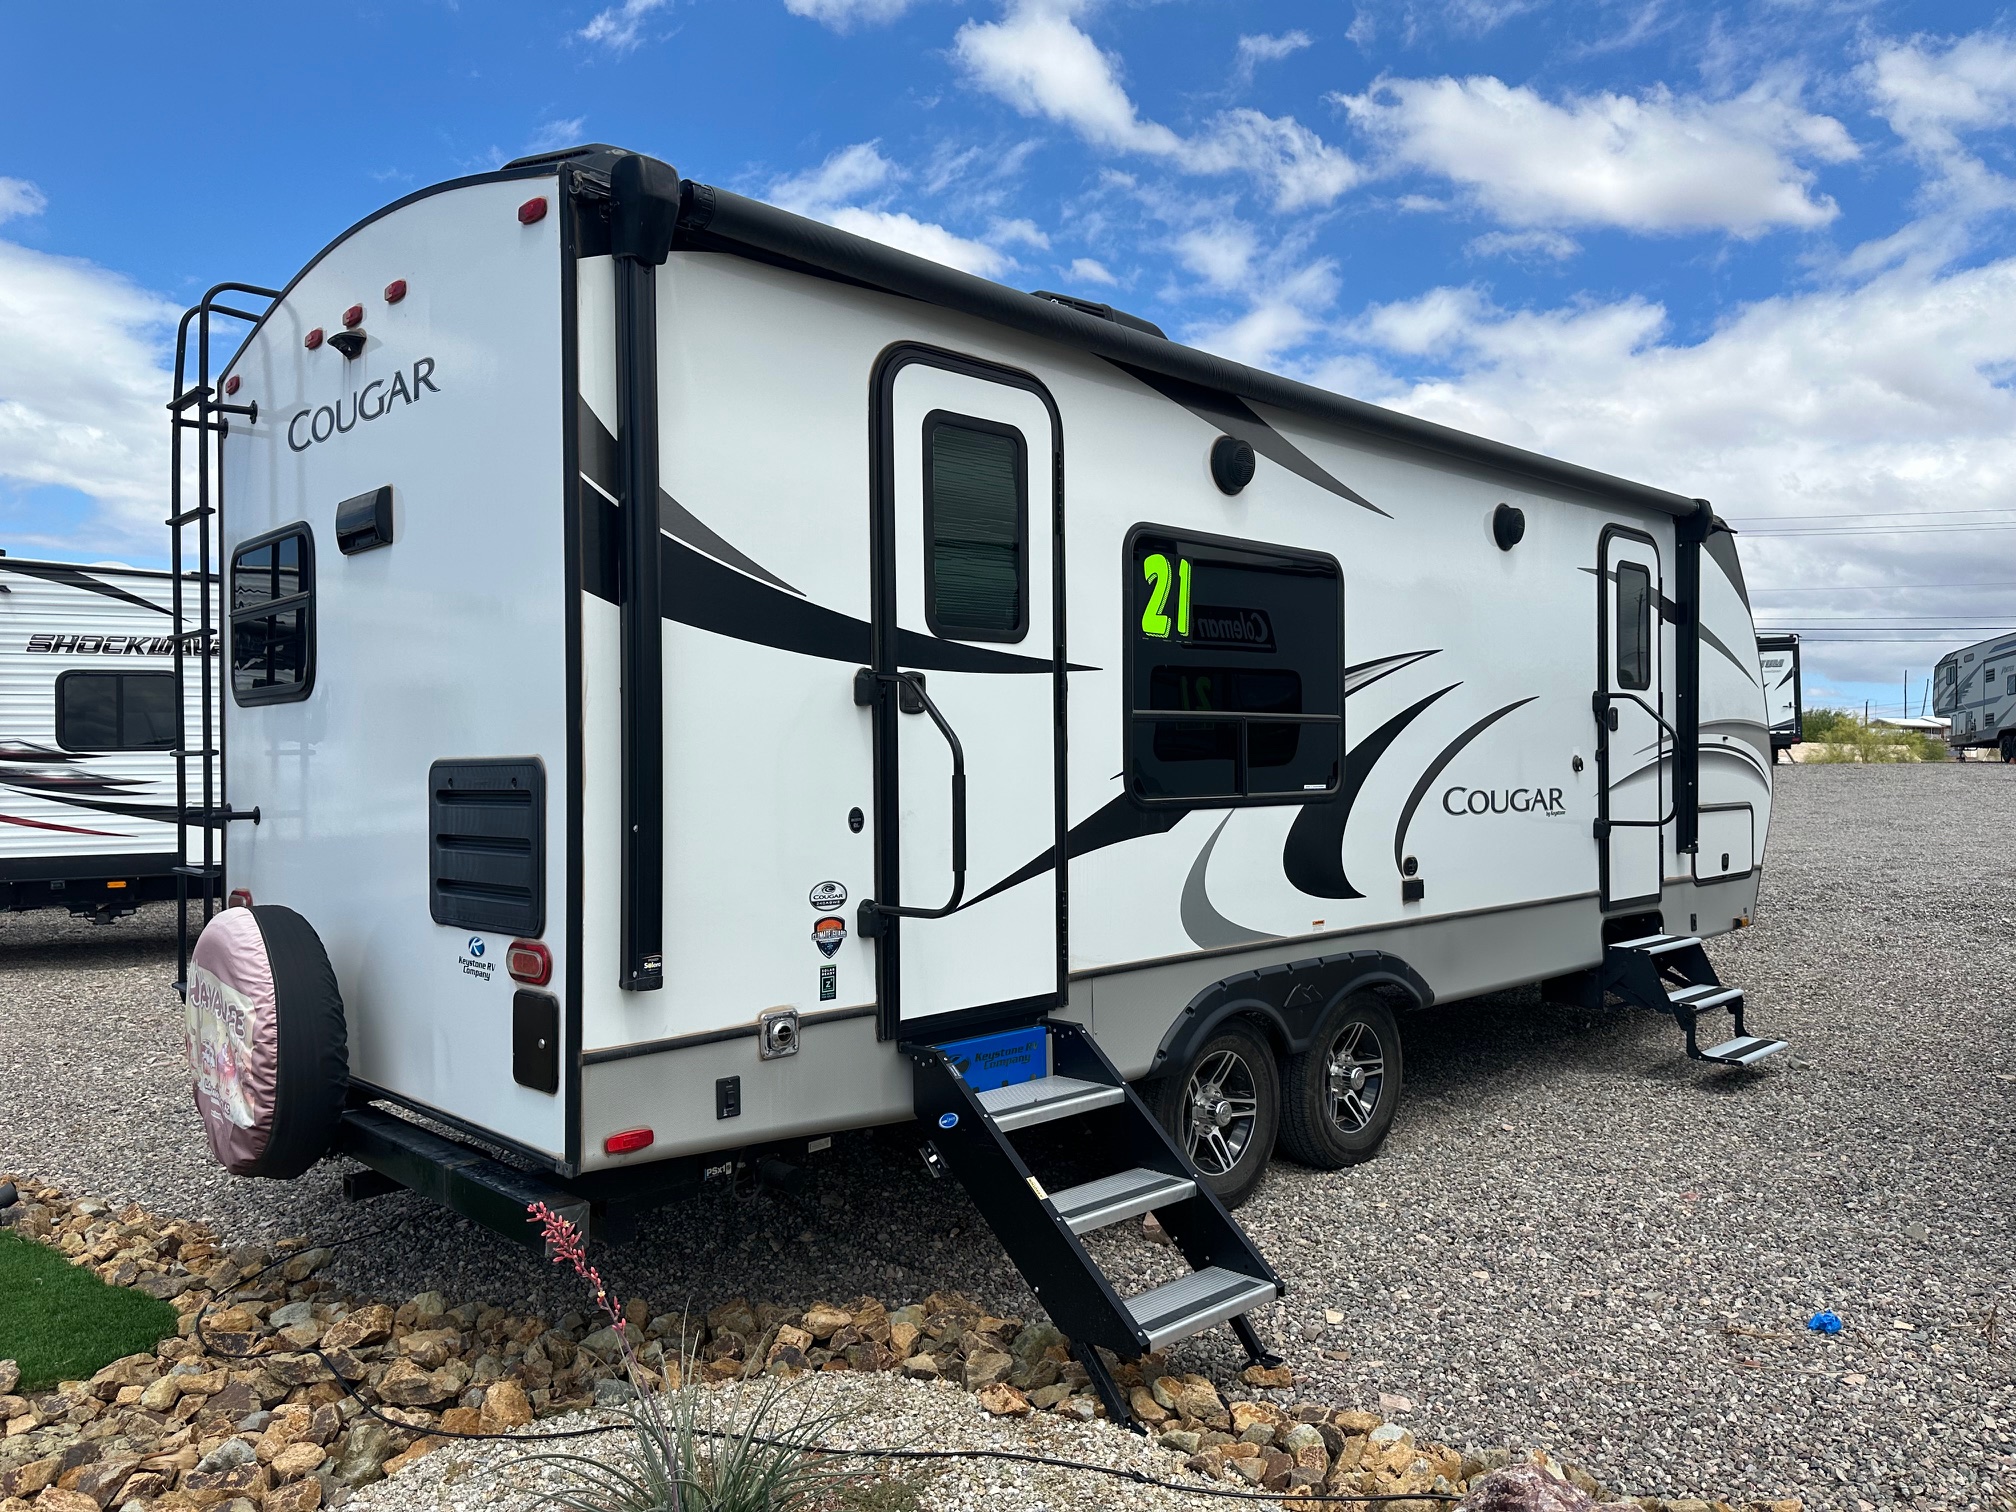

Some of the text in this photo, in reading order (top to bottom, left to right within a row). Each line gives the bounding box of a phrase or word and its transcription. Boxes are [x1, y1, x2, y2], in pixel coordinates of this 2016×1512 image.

[287, 356, 441, 453] COUGAR
[1141, 553, 1192, 639] 21
[1442, 786, 1566, 816] COUGAR
[458, 955, 496, 972] Keystone RV
[463, 965, 491, 981] Company
[974, 1042, 1039, 1062] Keystone RV
[983, 1054, 1031, 1070] Company
